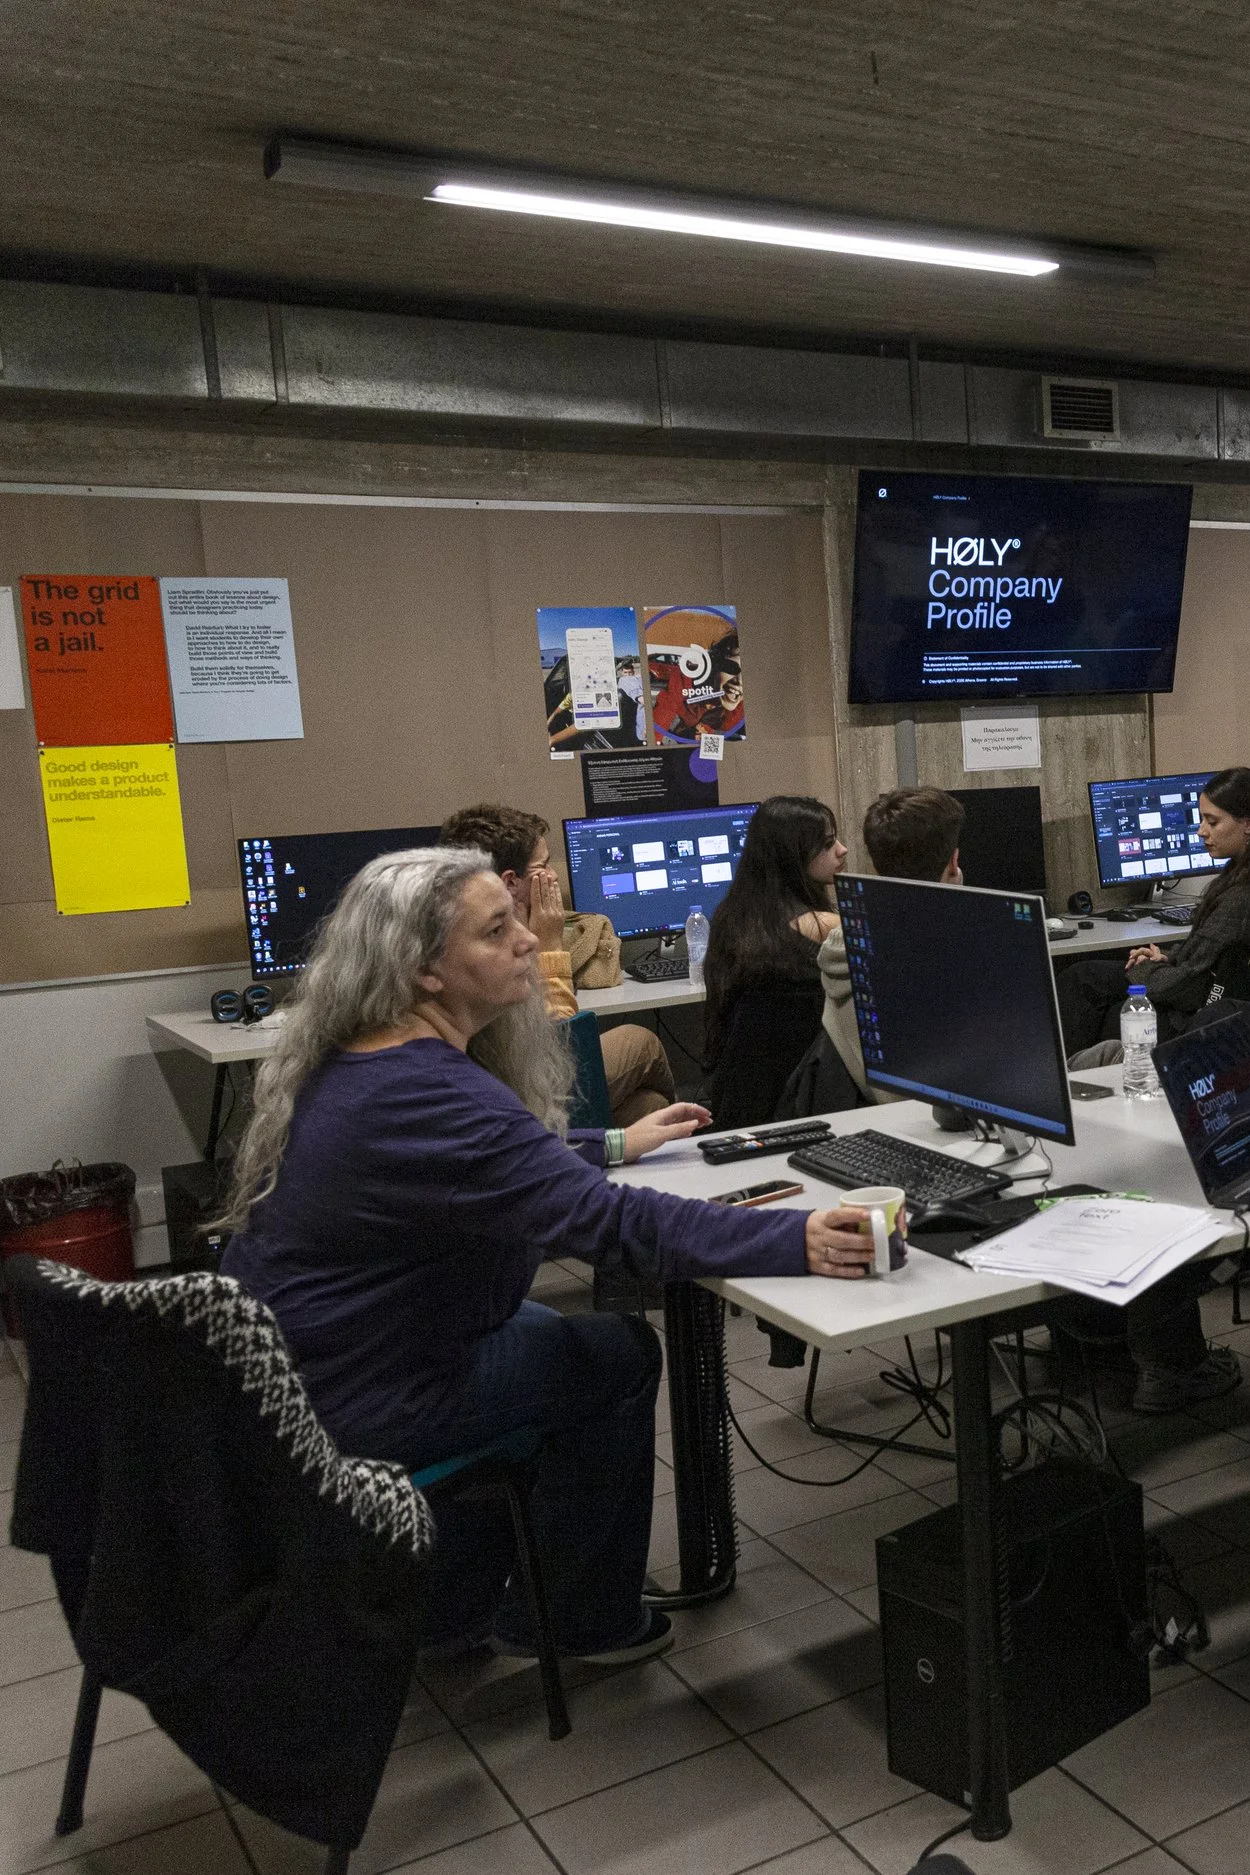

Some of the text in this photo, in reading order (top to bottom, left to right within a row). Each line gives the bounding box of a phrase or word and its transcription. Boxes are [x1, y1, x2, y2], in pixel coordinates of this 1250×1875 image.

[27, 580, 139, 604] The grid
[928, 570, 1062, 603] Company
[30, 606, 106, 626] is not
[927, 602, 1011, 629] Profile
[34, 632, 104, 656] a jail.
[682, 686, 713, 697] spotit
[46, 760, 138, 774] Good design
[48, 772, 169, 788] makes a product
[50, 786, 166, 802] understandable.
[1197, 1089, 1237, 1117] Company
[1203, 1112, 1231, 1135] Profile
